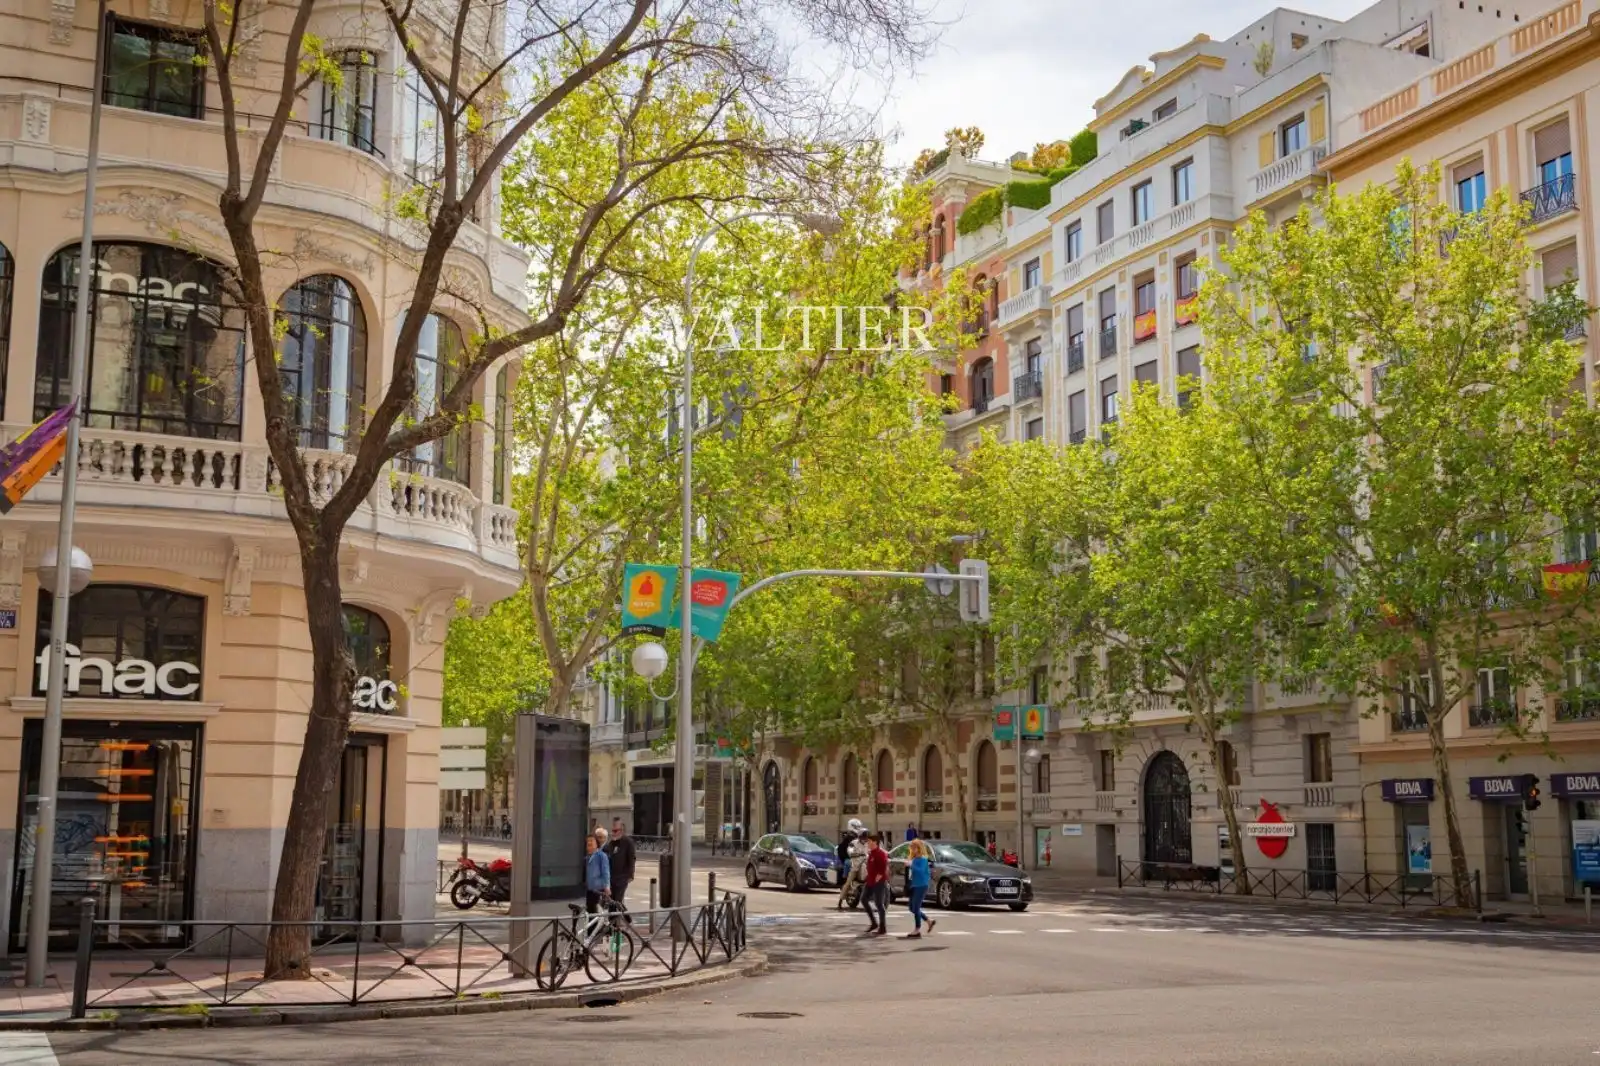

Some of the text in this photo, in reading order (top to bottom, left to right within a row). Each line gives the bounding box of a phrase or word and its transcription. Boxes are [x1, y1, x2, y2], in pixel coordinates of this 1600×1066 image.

[74, 258, 209, 310] fnac
[36, 643, 200, 696] fnac
[353, 676, 398, 710] ac
[1395, 782, 1422, 795] BBVA
[1484, 779, 1515, 793] BBVA
[1566, 776, 1600, 791] BBVA
